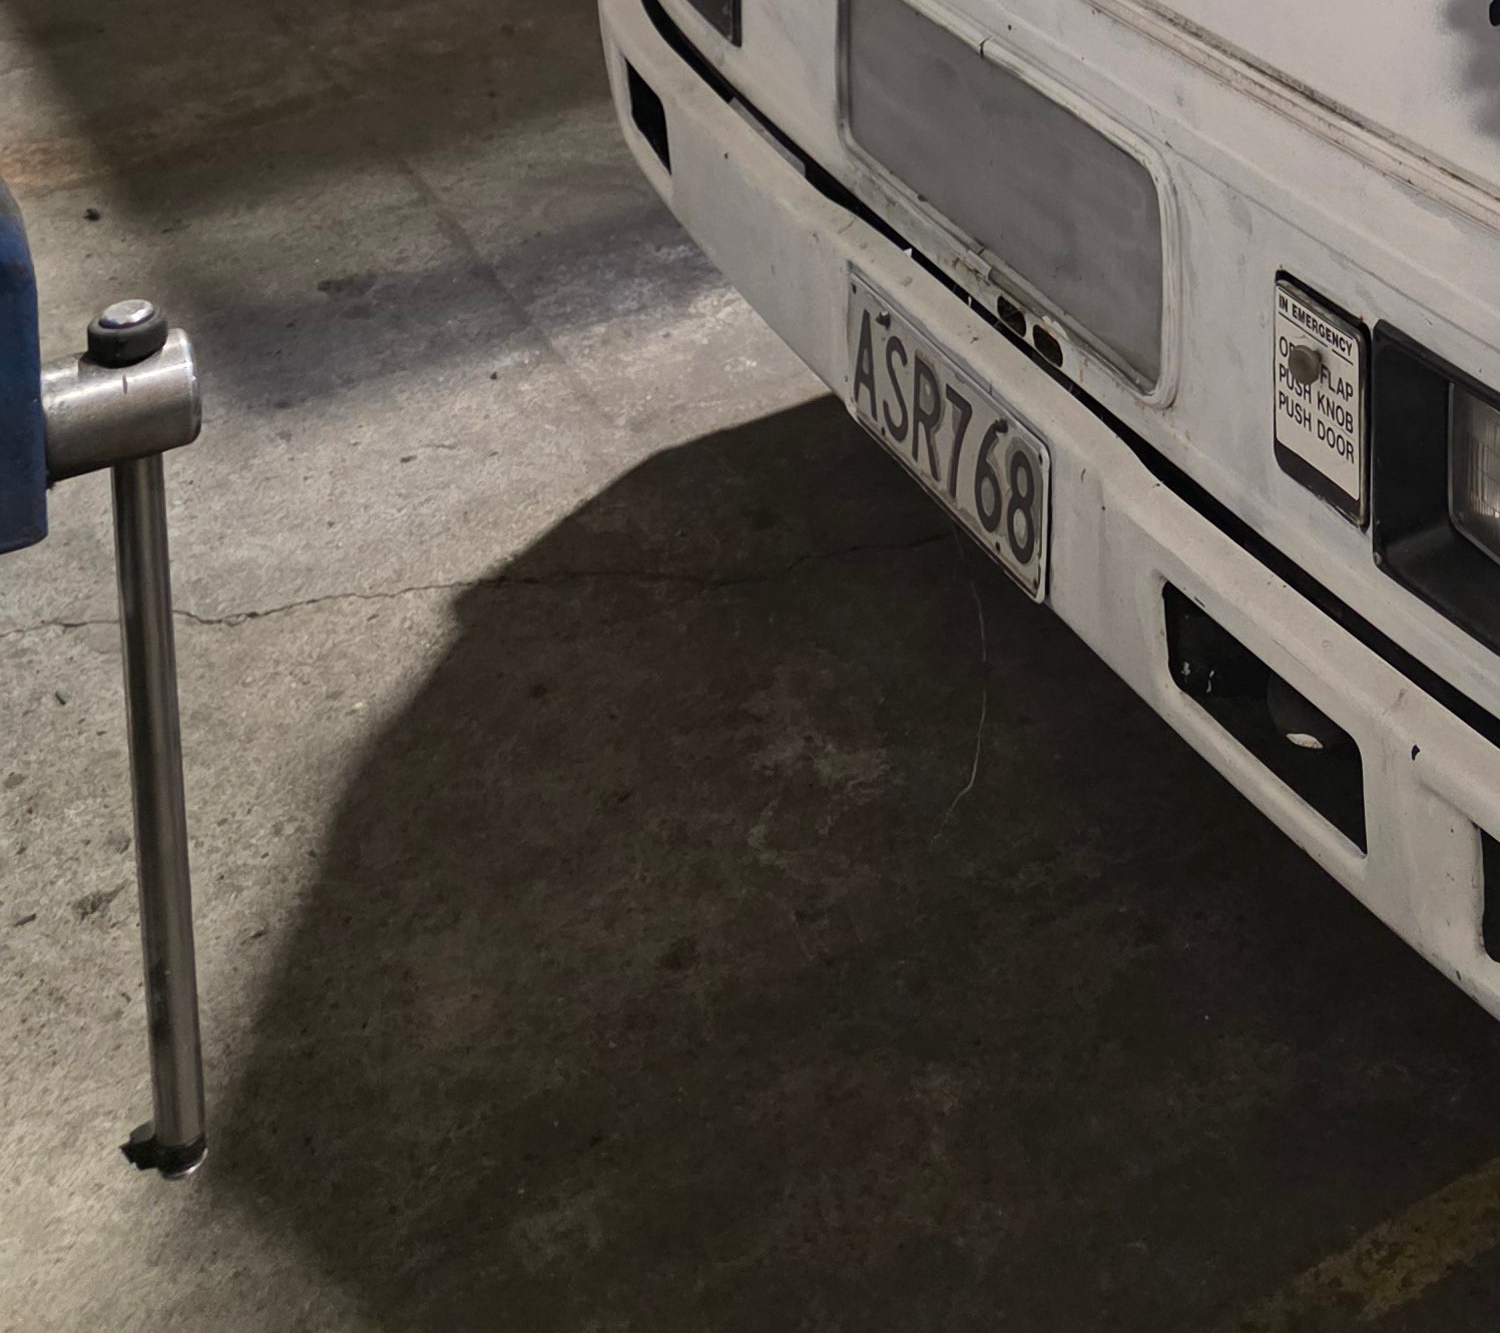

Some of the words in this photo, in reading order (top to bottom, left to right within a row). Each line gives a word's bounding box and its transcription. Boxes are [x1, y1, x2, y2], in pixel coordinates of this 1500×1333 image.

[1278, 294, 1289, 314] IN
[1291, 304, 1353, 358] EMERGENCY
[1317, 391, 1354, 434] KNOB
[1320, 363, 1354, 403] FLAP
[854, 309, 1036, 565] ASR768
[1278, 390, 1312, 433] PUSH
[1317, 419, 1355, 465] DOOR
